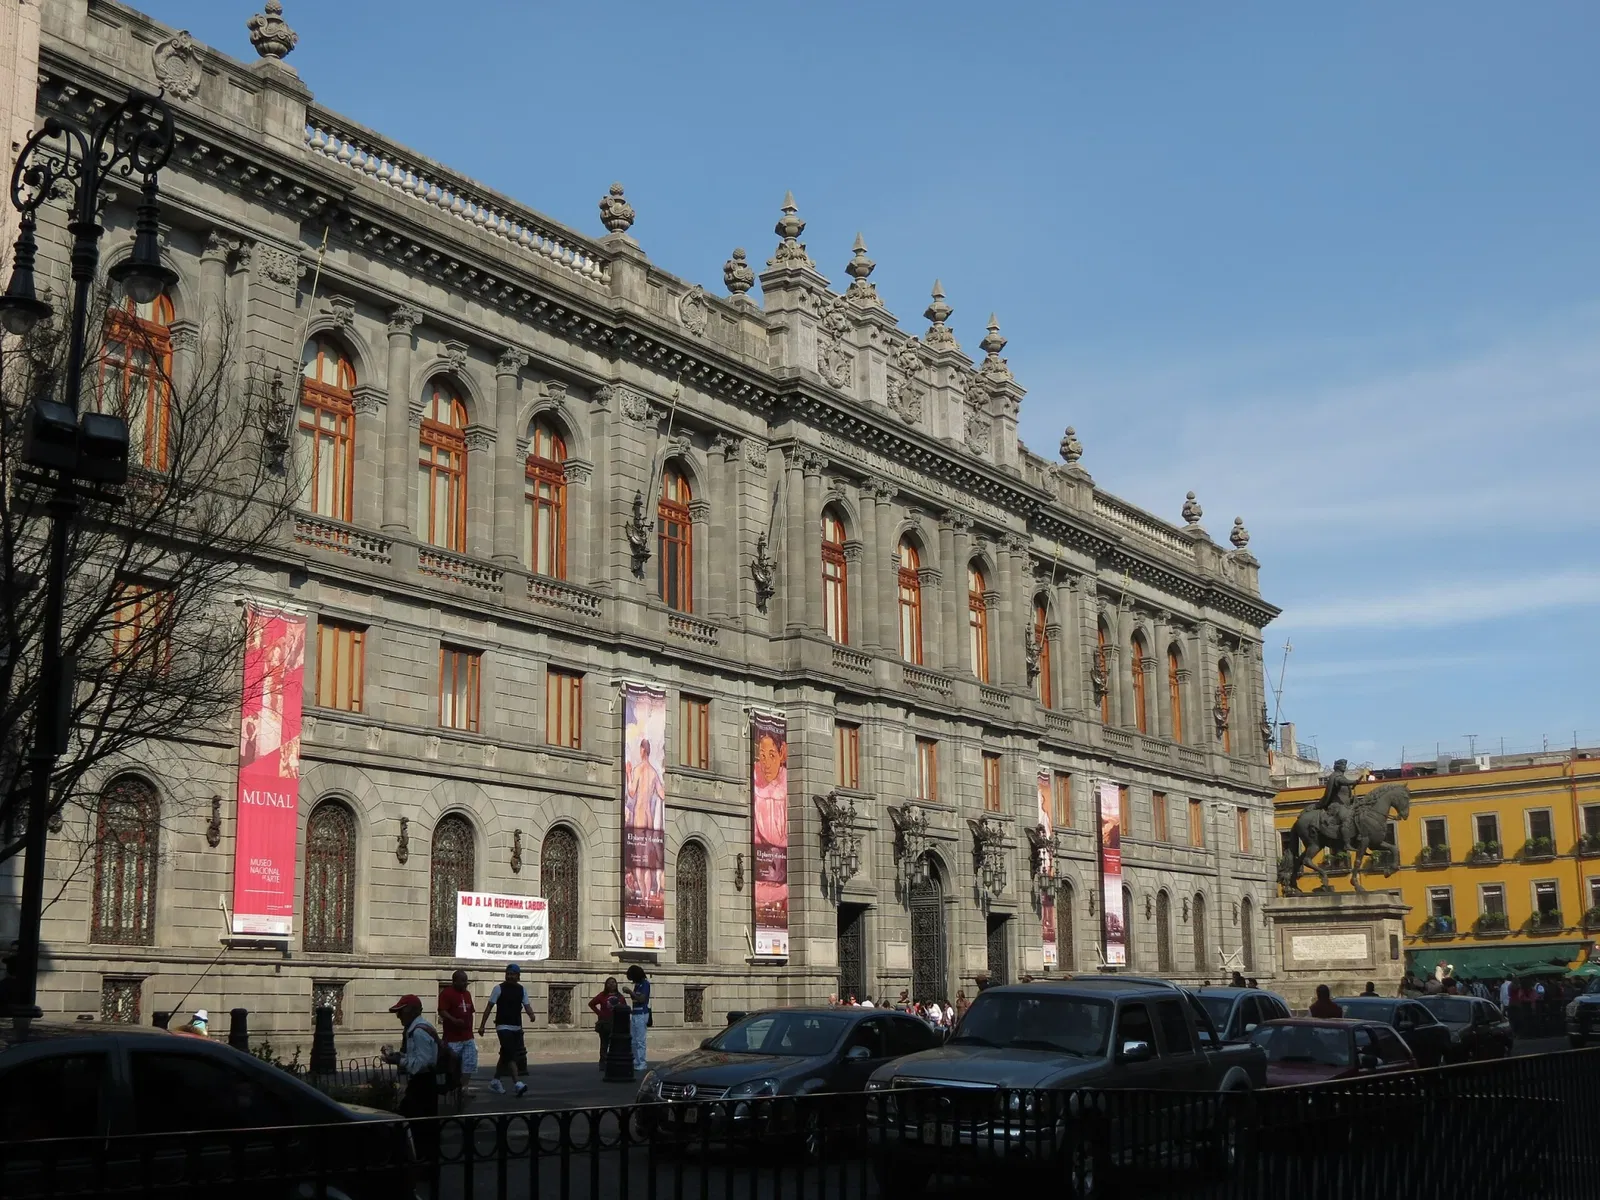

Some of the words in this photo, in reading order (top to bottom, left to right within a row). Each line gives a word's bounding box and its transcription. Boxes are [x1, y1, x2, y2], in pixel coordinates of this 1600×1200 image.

[242, 789, 294, 809] MUNAL
[250, 858, 272, 867] MUSEO
[250, 866, 280, 876] NACIONAL
[266, 875, 280, 884] ARTE
[461, 896, 473, 906] NO
[475, 897, 481, 907] A
[484, 897, 493, 907] LA
[494, 898, 523, 910] REFORMA
